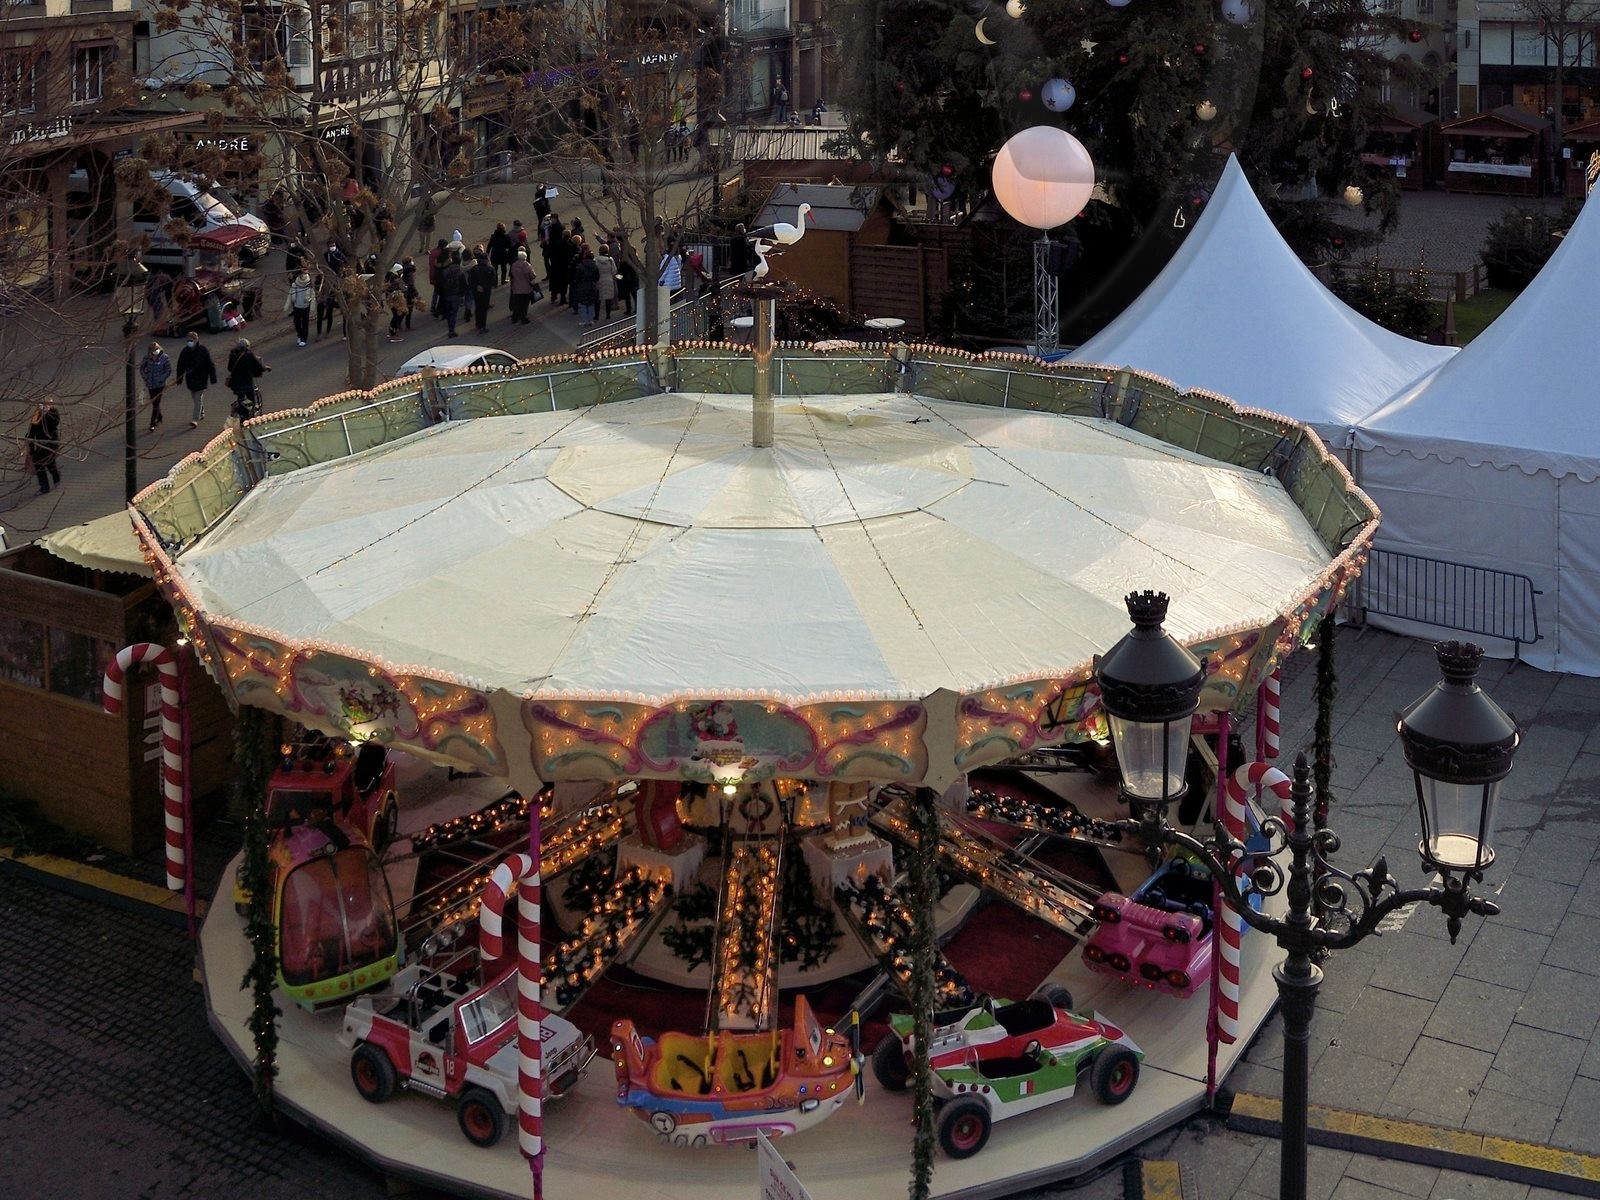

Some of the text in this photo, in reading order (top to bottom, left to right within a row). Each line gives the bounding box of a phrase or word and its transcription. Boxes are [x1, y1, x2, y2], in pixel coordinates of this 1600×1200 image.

[325, 124, 351, 139] ANDRÉ
[195, 136, 249, 151] ANDRÉ
[446, 1058, 455, 1076] 18
